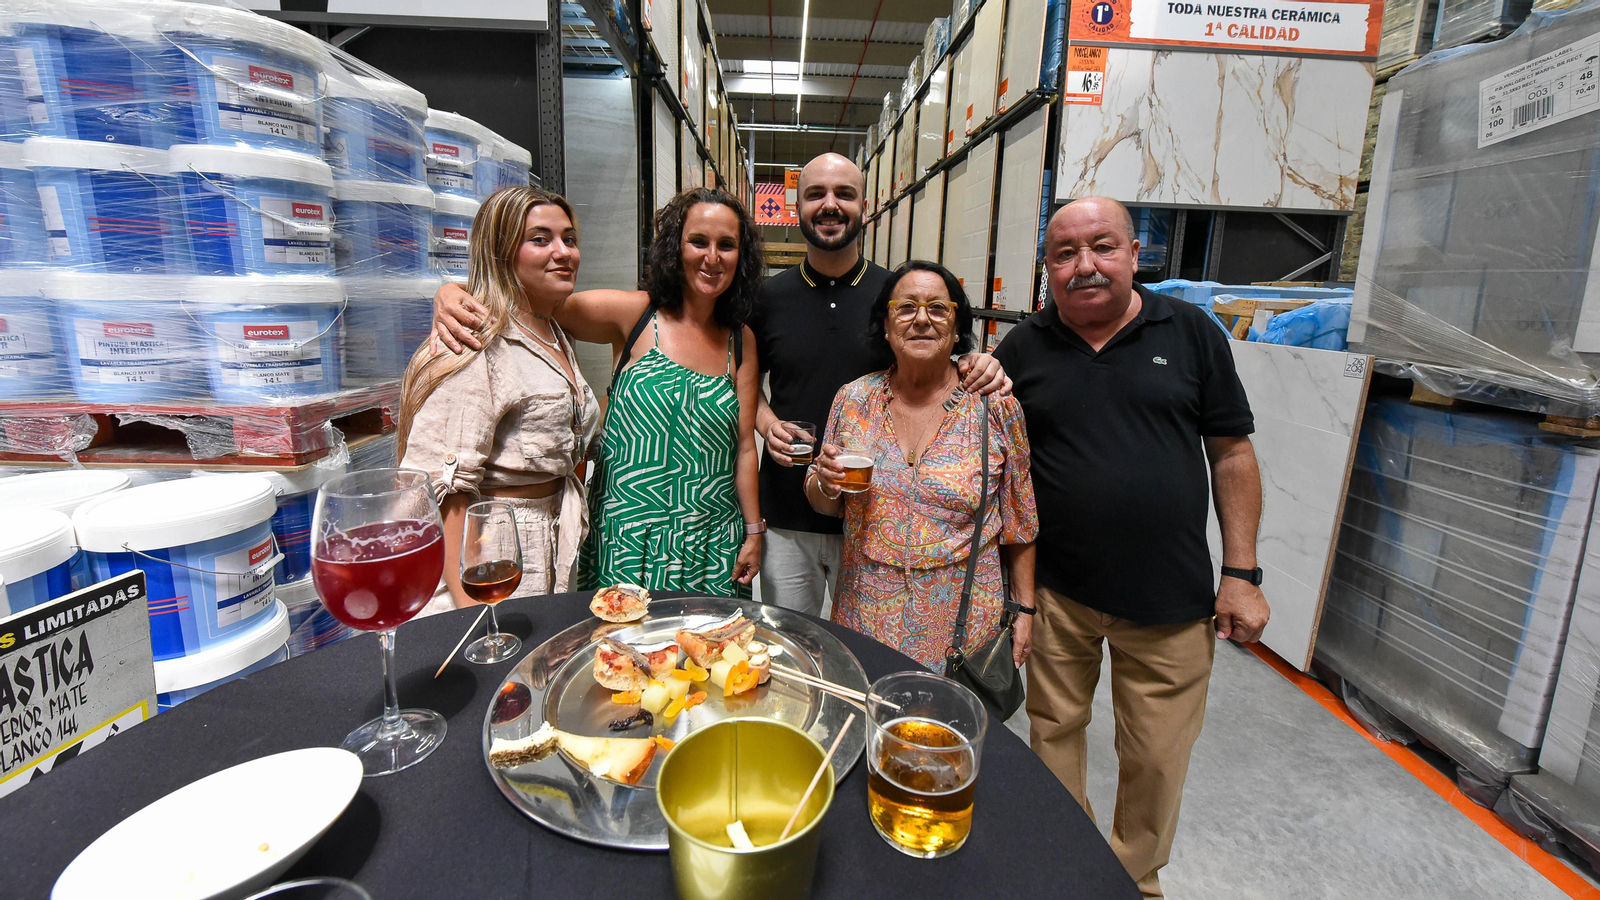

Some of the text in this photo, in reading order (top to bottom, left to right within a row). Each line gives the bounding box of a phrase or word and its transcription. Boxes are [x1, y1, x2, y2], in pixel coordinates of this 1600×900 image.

[1167, 2, 1340, 24] TODA NUESTRA CERÁMICA
[1088, 22, 1114, 32] CALIDAD
[1227, 24, 1300, 41] CALIDAD
[1504, 66, 1525, 78] VENDOR
[1526, 57, 1553, 68] INTERNAL
[1554, 48, 1573, 57] LABEL
[253, 72, 290, 84] eurotex
[1580, 71, 1593, 80] 48
[1558, 81, 1564, 90] 3
[1576, 84, 1595, 95] 70,49
[1491, 106, 1502, 114] 1A
[1489, 118, 1504, 128] 100
[24, 584, 140, 640] LIMITADAS
[49, 682, 88, 720] MATE
[0, 727, 52, 773] LANCO
